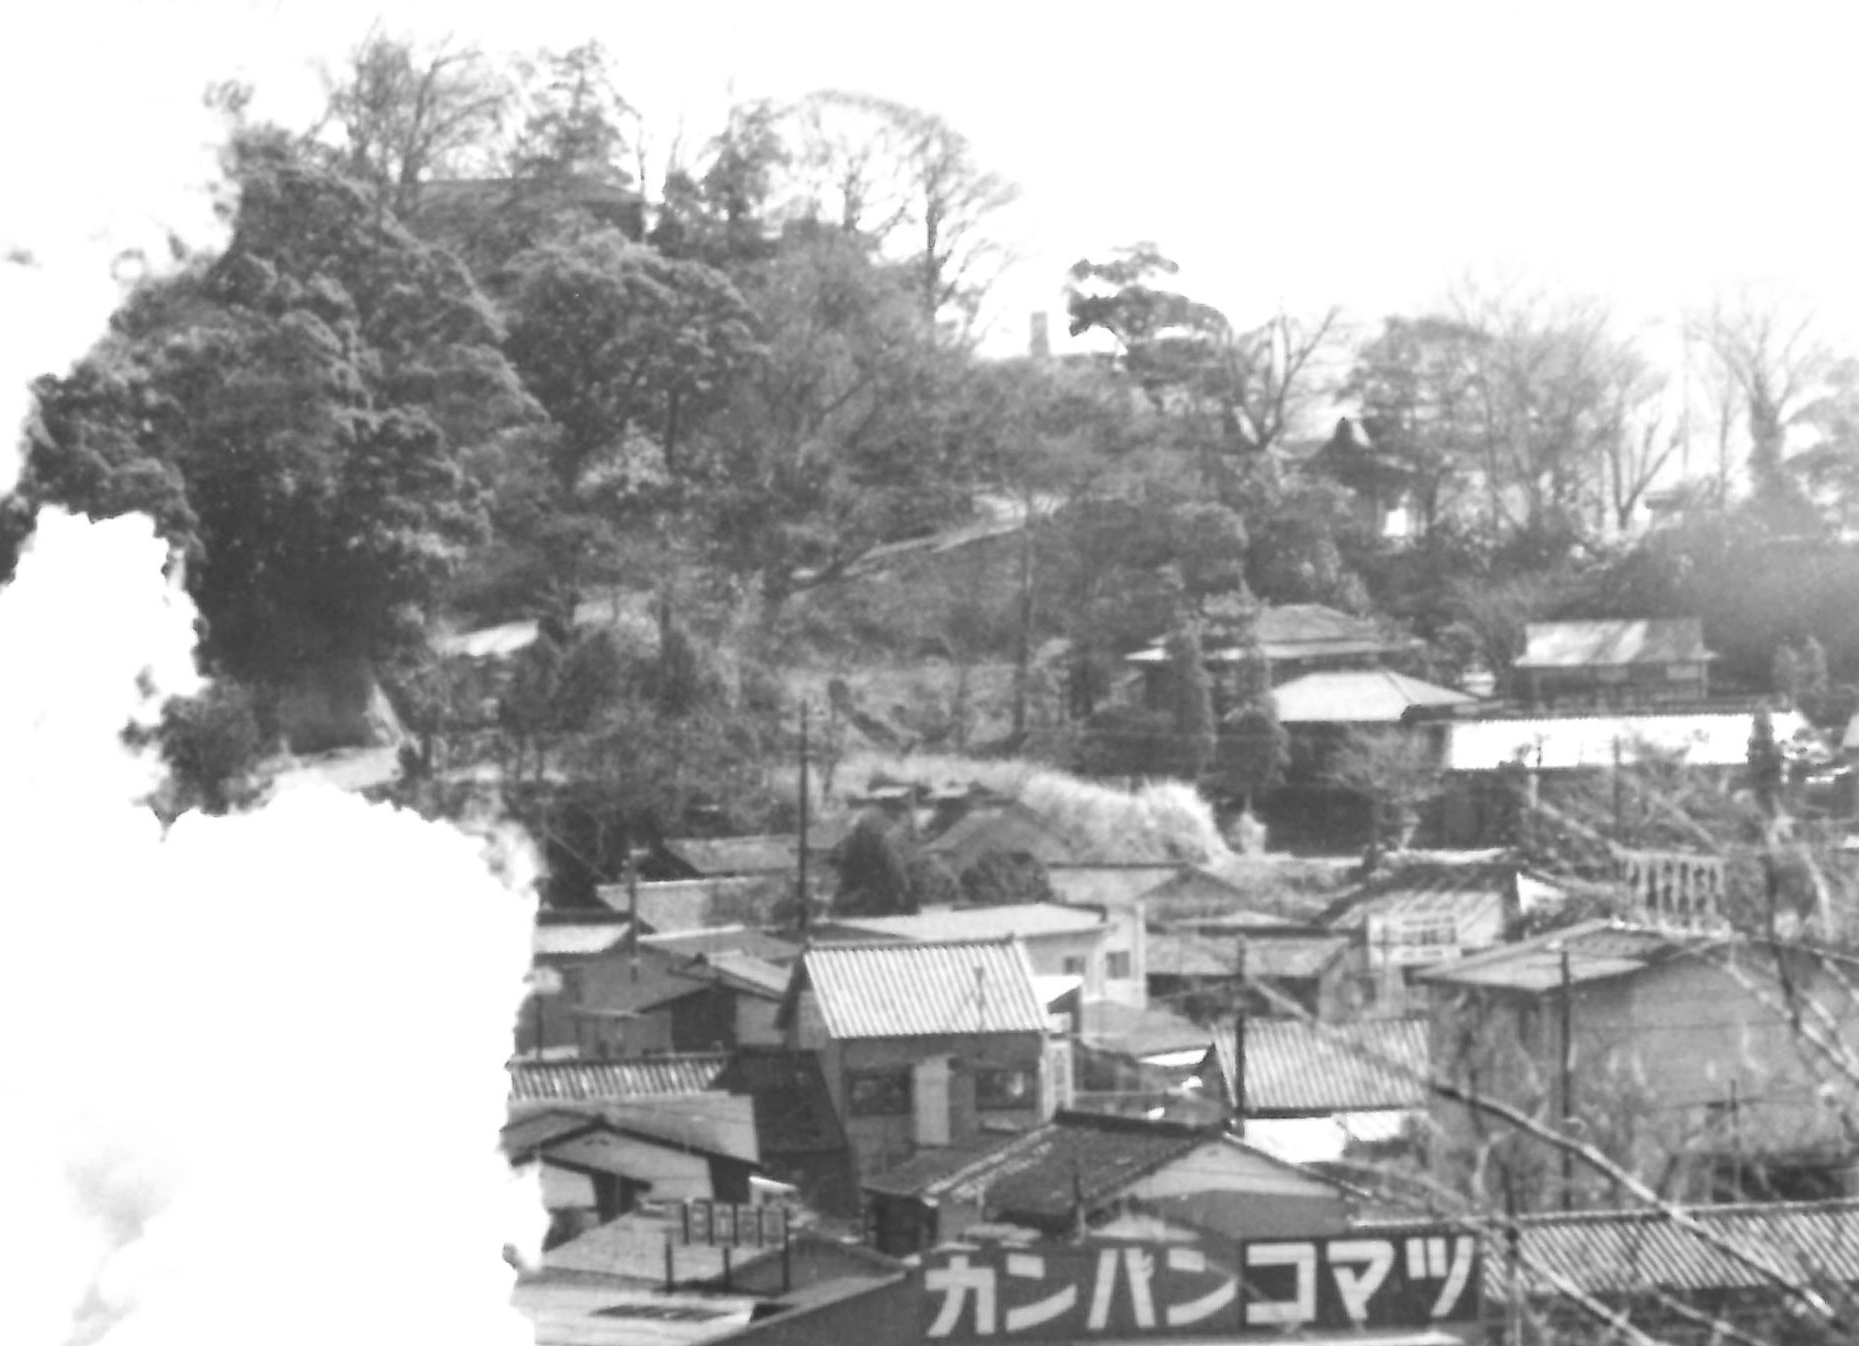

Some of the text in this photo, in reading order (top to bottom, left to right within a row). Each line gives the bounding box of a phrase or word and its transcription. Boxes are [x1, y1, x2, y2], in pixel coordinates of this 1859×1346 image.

[925, 1235, 1475, 1338] カンバンコマツ
